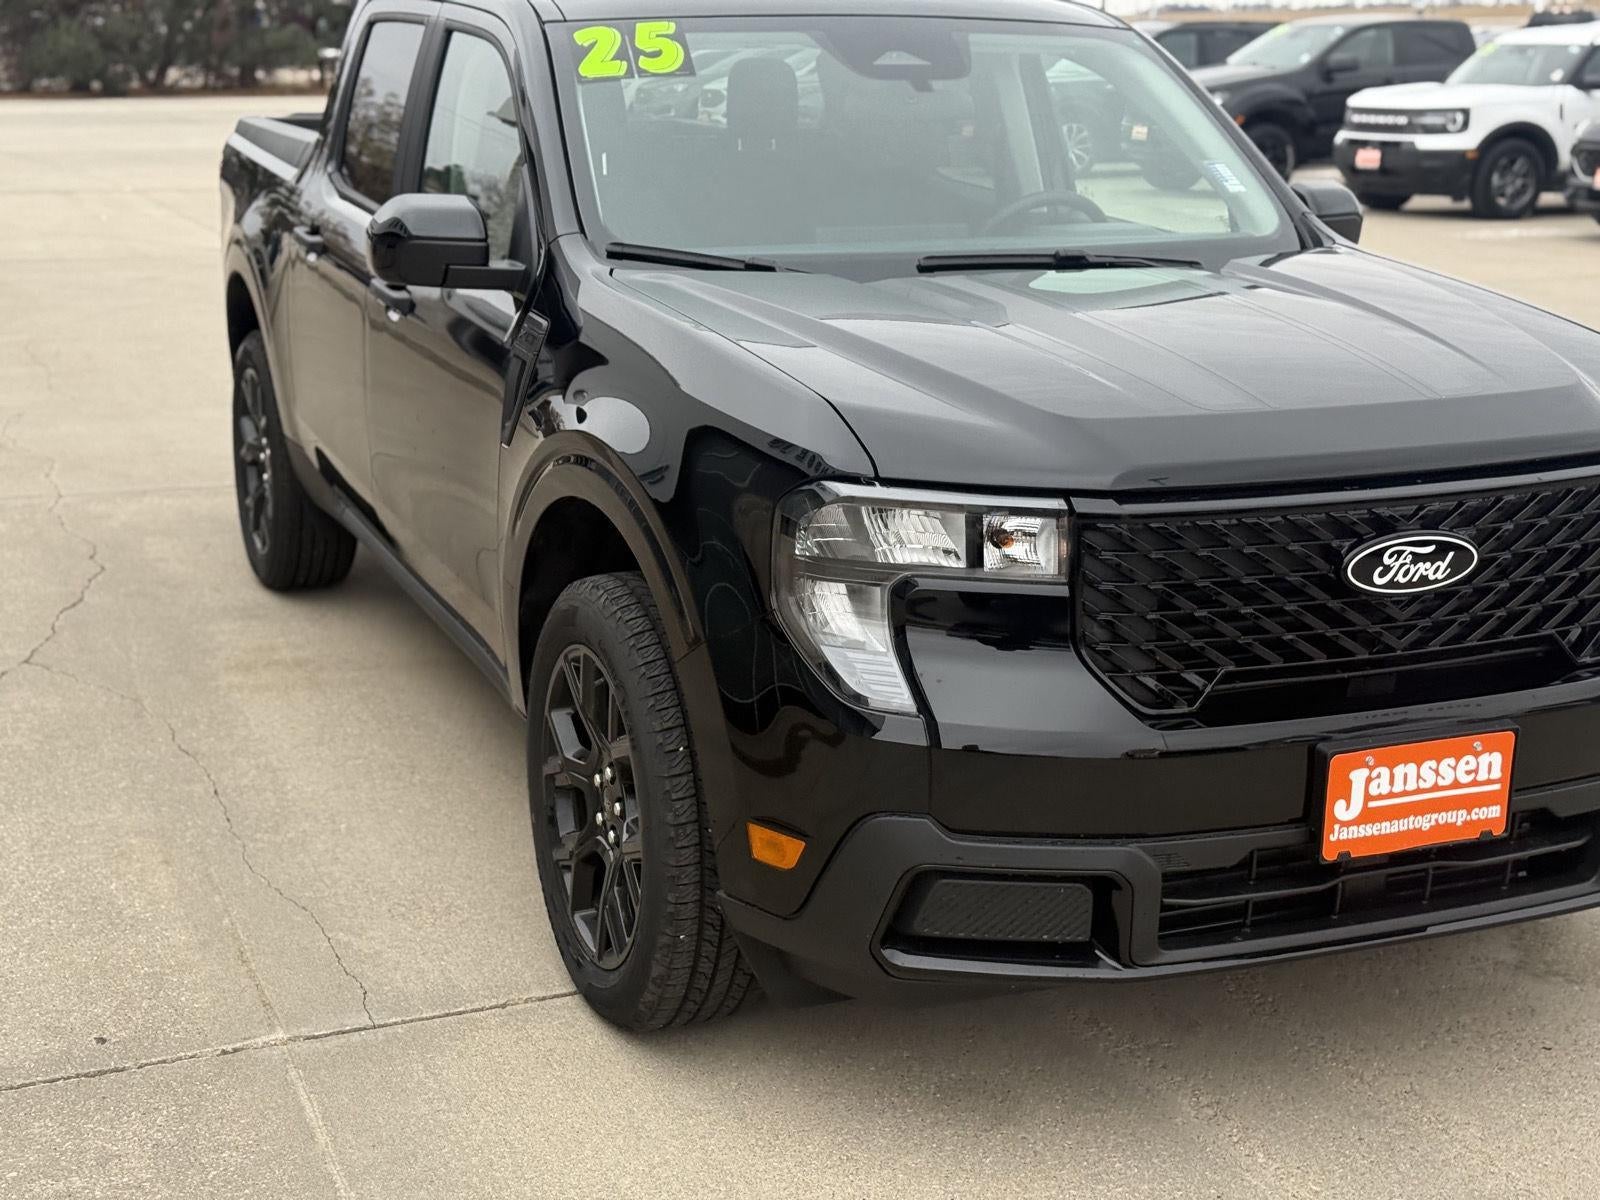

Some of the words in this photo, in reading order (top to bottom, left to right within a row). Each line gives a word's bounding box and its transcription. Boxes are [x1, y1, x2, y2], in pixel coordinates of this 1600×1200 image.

[573, 21, 685, 78] 25
[1372, 544, 1456, 586] Ford
[1333, 750, 1504, 822] Janssen
[1329, 804, 1502, 842] Janssenautogroup.com
